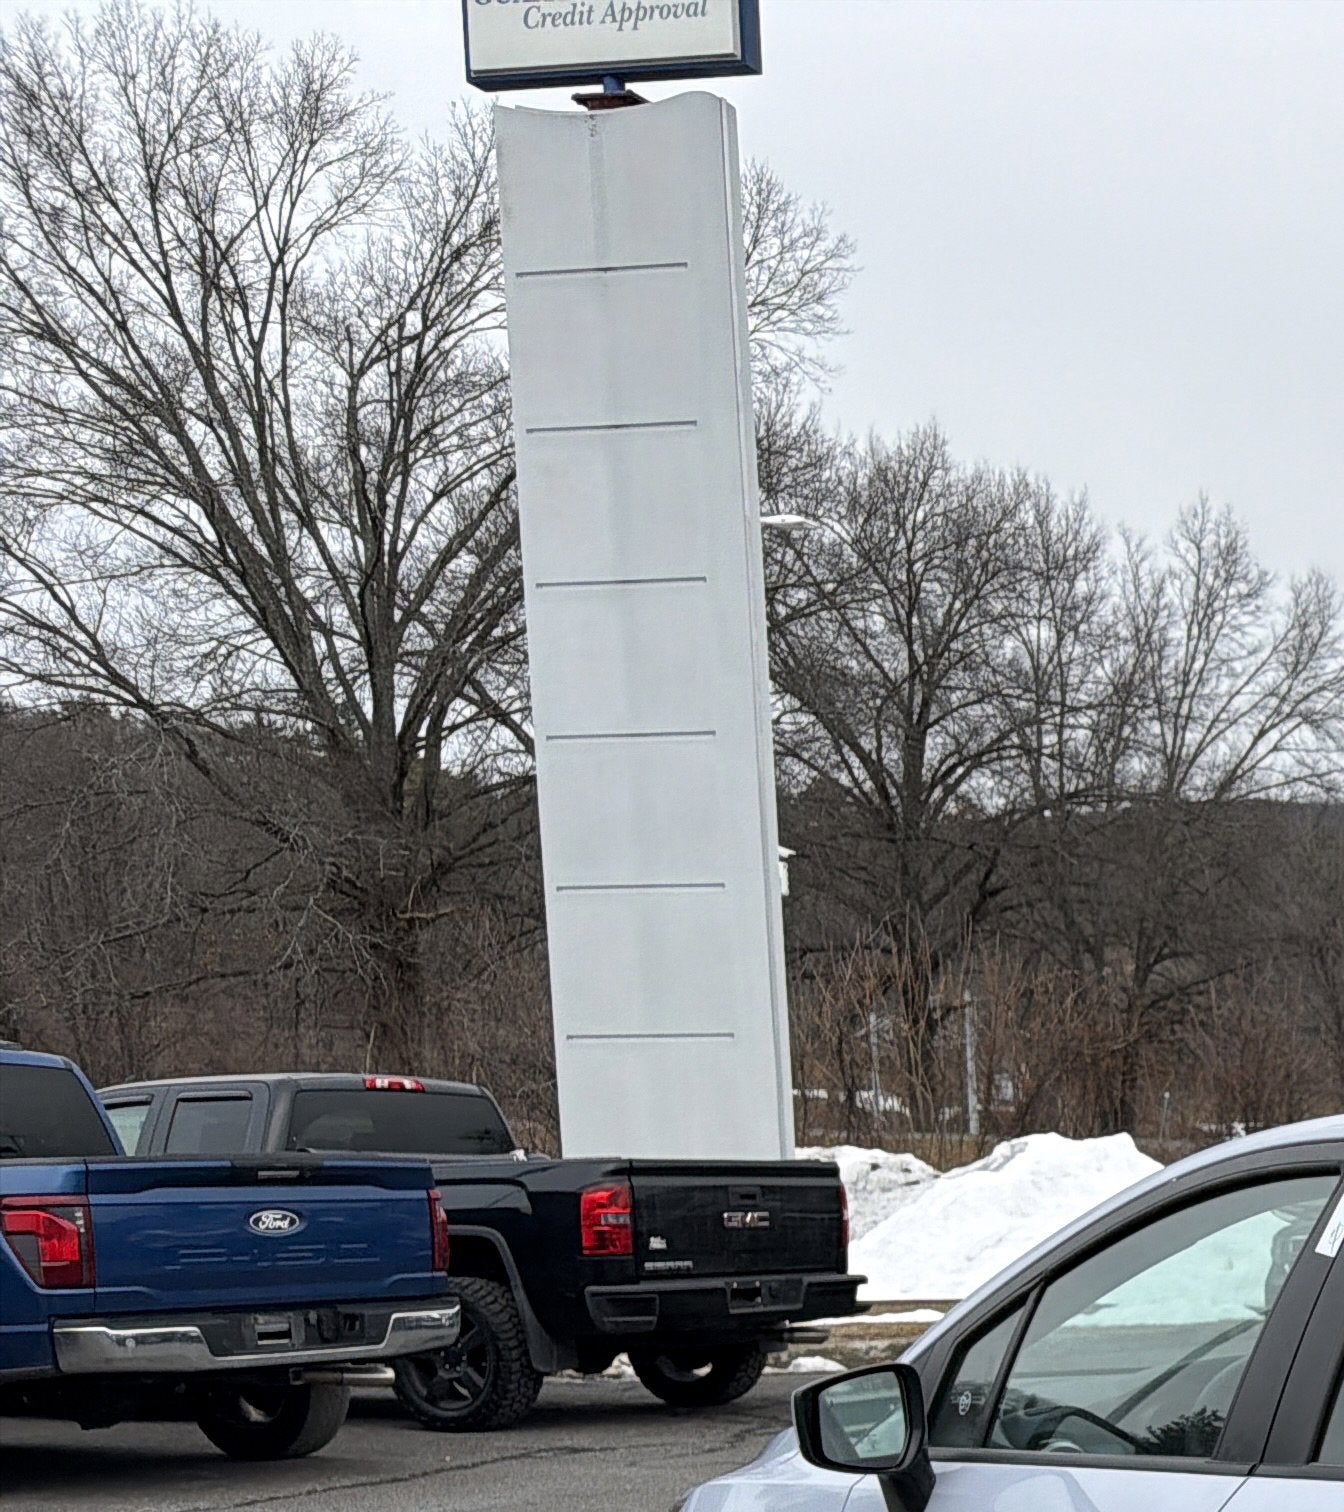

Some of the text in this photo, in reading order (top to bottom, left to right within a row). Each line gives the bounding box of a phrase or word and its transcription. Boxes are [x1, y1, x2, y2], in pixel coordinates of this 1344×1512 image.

[523, 0, 708, 31] Credit Approval
[258, 1214, 290, 1229] Ford
[723, 1211, 770, 1228] GMC
